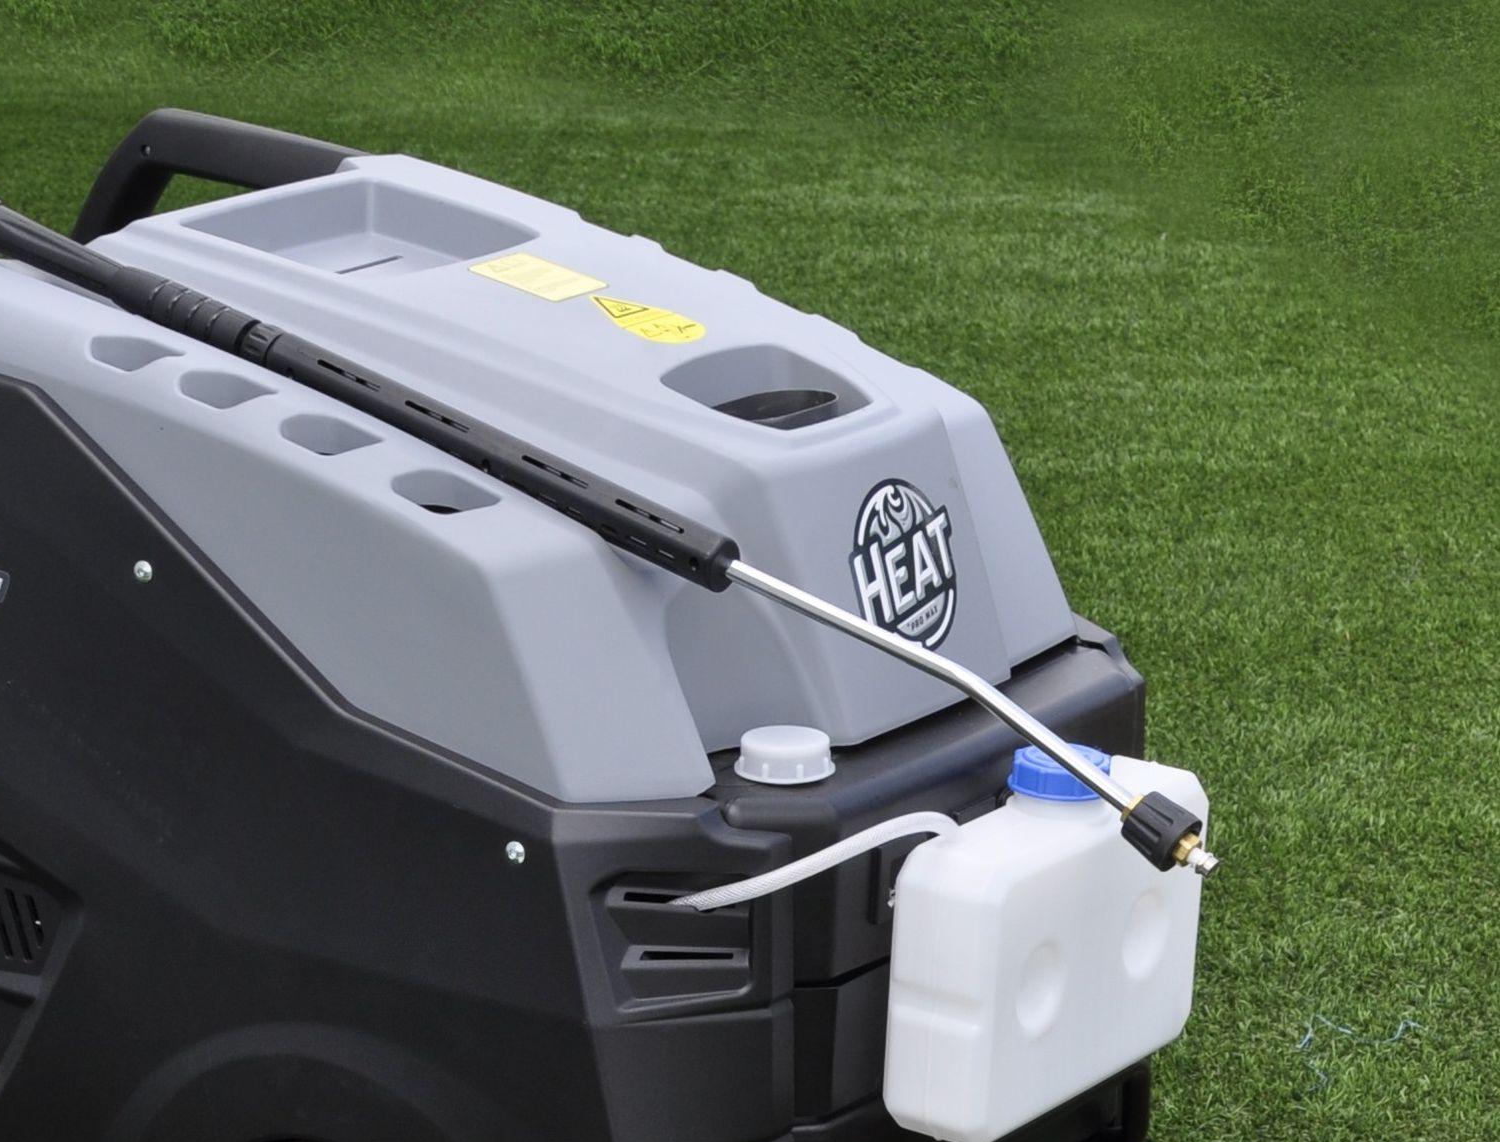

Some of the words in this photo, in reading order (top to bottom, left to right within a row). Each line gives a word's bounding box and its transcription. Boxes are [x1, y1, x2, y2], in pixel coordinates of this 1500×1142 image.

[853, 512, 953, 626] HEAT
[911, 615, 924, 631] PRO
[925, 605, 938, 620] MAX
